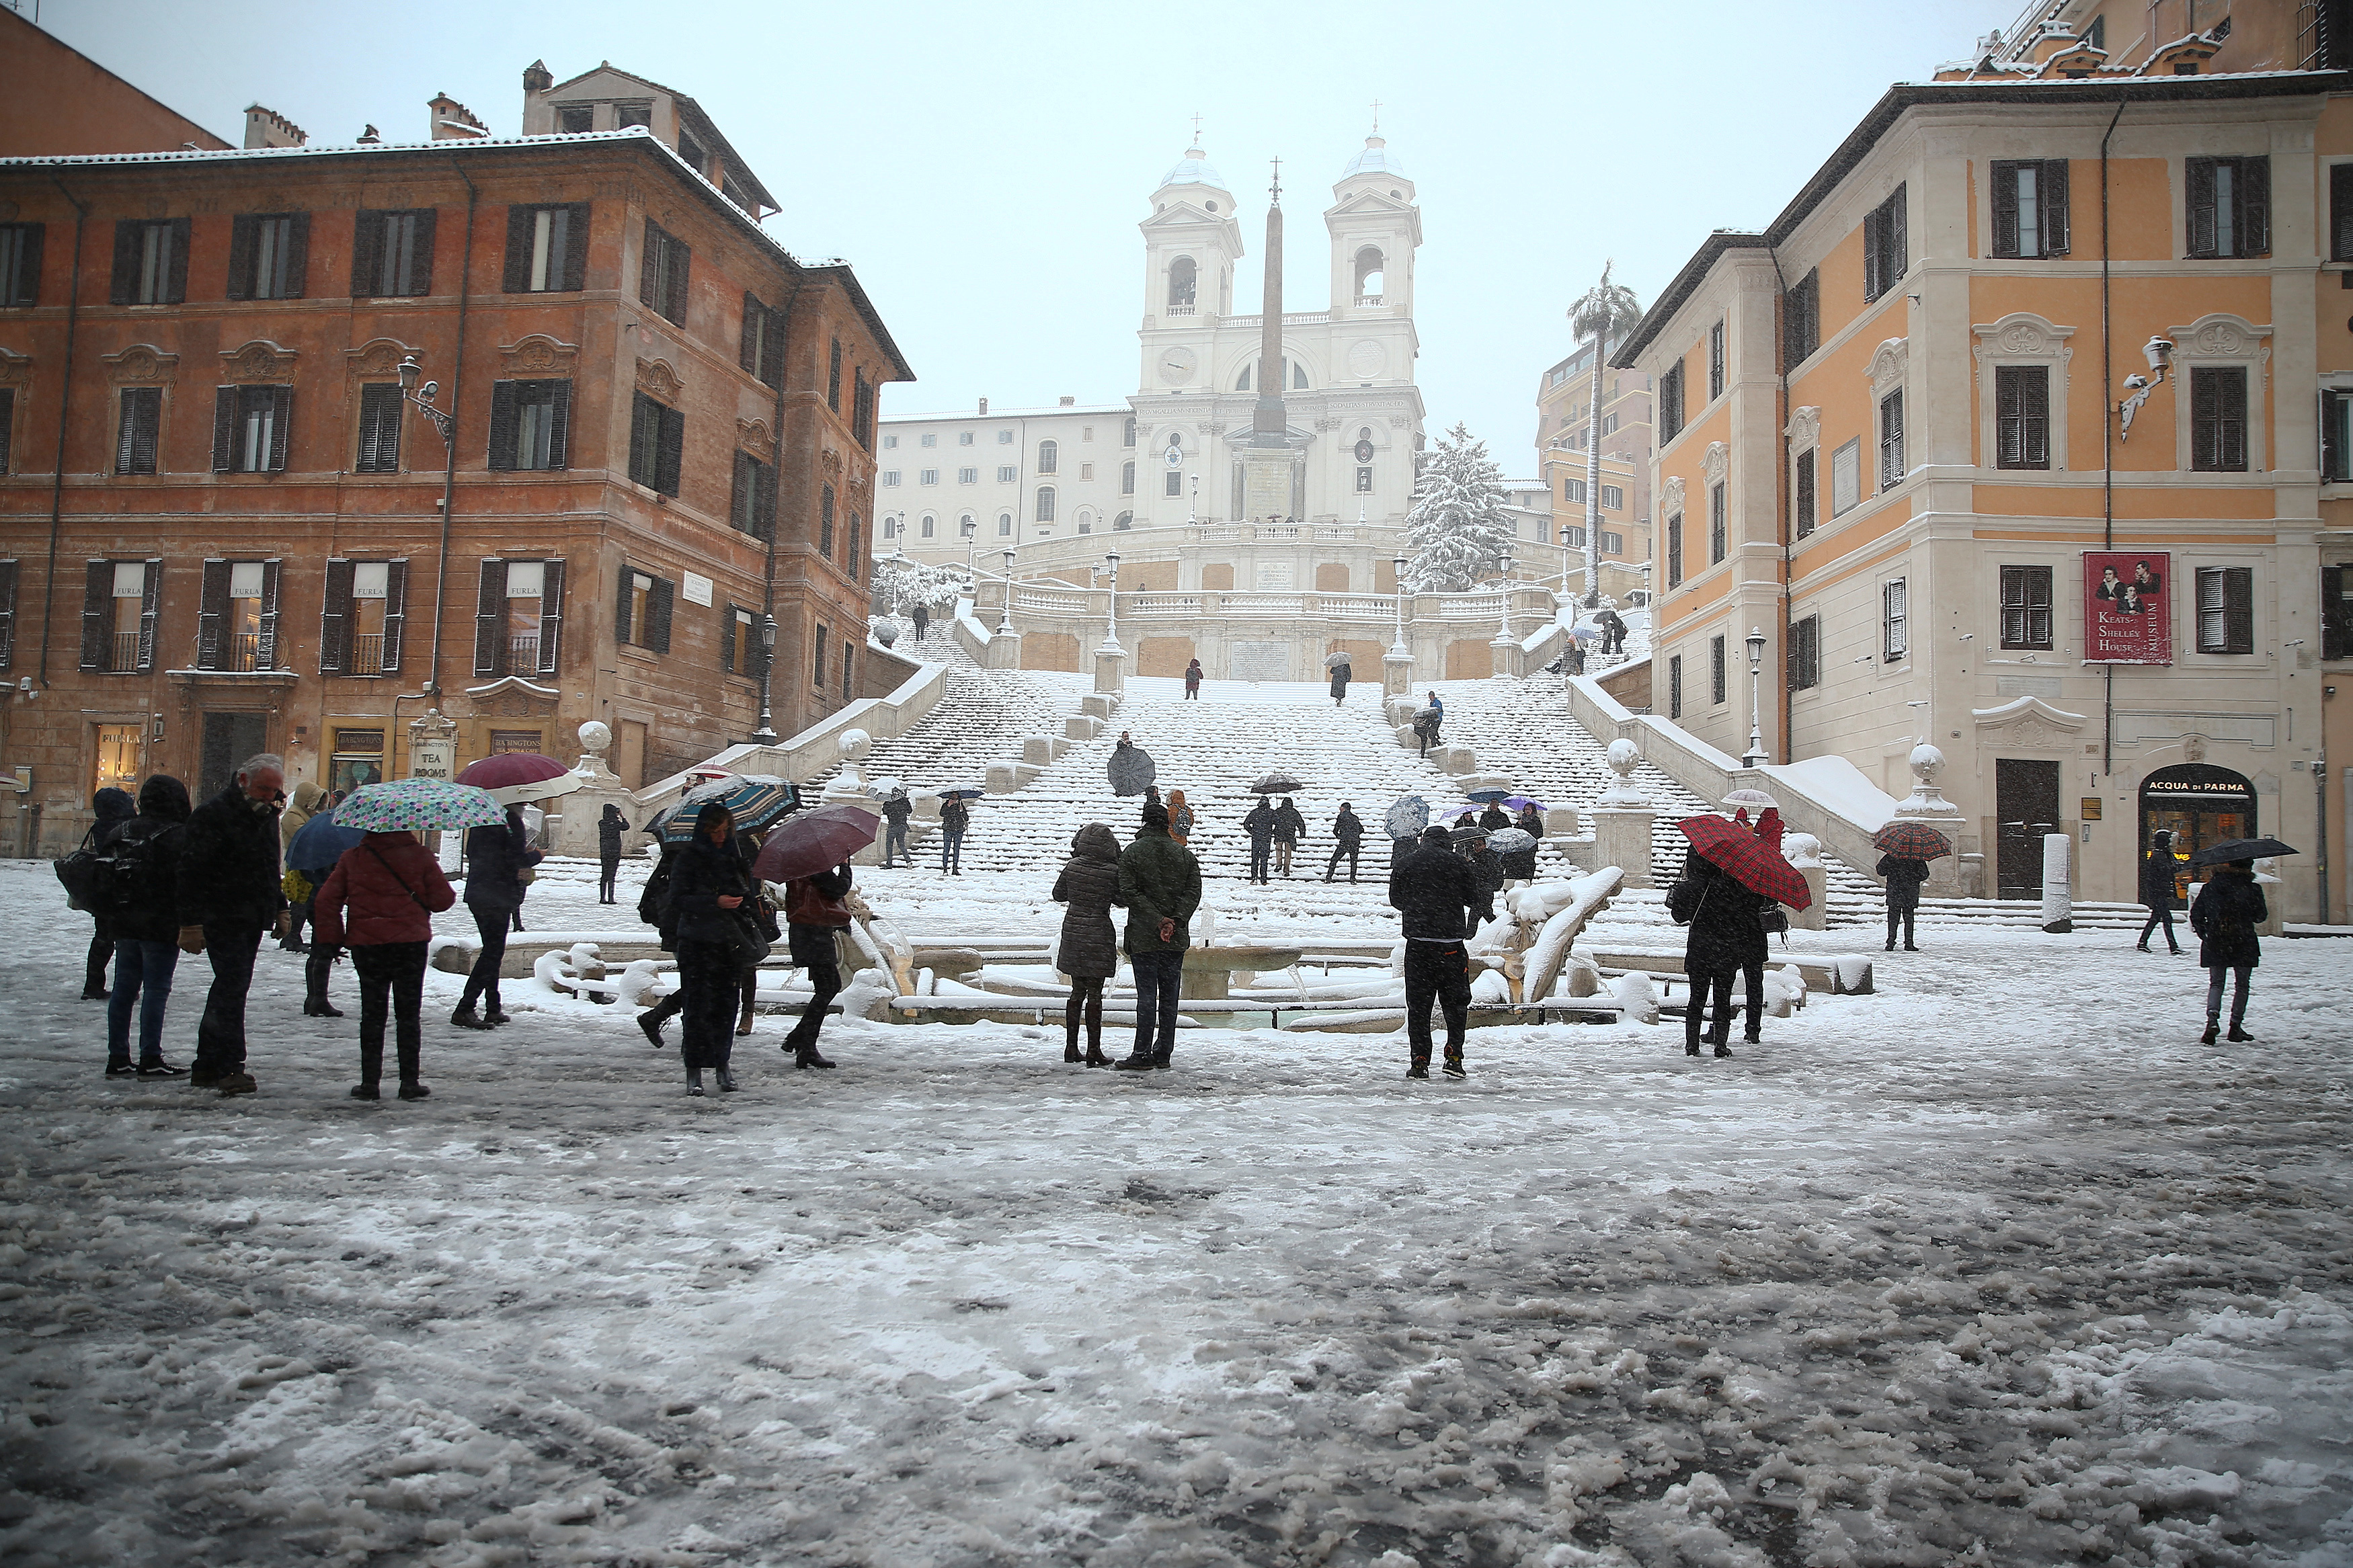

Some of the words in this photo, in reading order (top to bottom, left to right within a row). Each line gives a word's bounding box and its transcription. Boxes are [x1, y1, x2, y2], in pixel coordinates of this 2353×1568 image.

[2099, 625, 2141, 637] SHELLEY
[2147, 603, 2157, 651] MUSEUM
[2099, 639, 2132, 651] HOUSE
[103, 734, 140, 743] FURLA
[422, 754, 441, 763] TEA
[415, 768, 446, 778] ROOMS
[2149, 782, 2189, 790] ACQUA
[2204, 783, 2245, 791] PARMA
